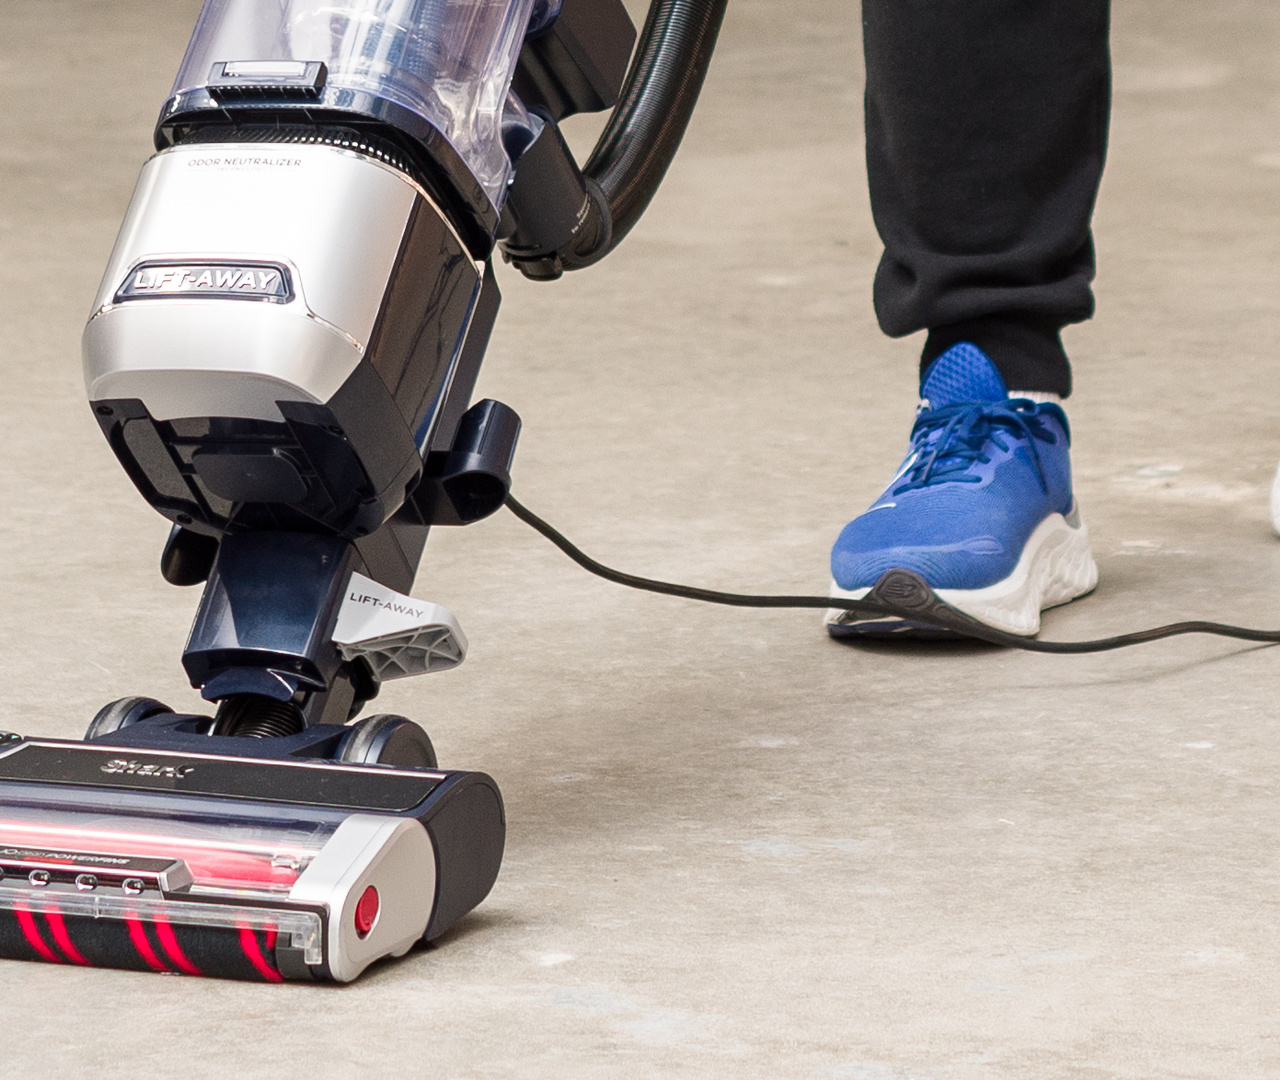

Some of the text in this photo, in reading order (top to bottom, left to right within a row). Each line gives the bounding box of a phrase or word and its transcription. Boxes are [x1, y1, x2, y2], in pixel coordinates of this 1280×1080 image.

[188, 157, 302, 167] ODOR NEUTRALIZER
[134, 270, 276, 290] LIFT-AWAY
[349, 592, 424, 618] LIFT-AWAY
